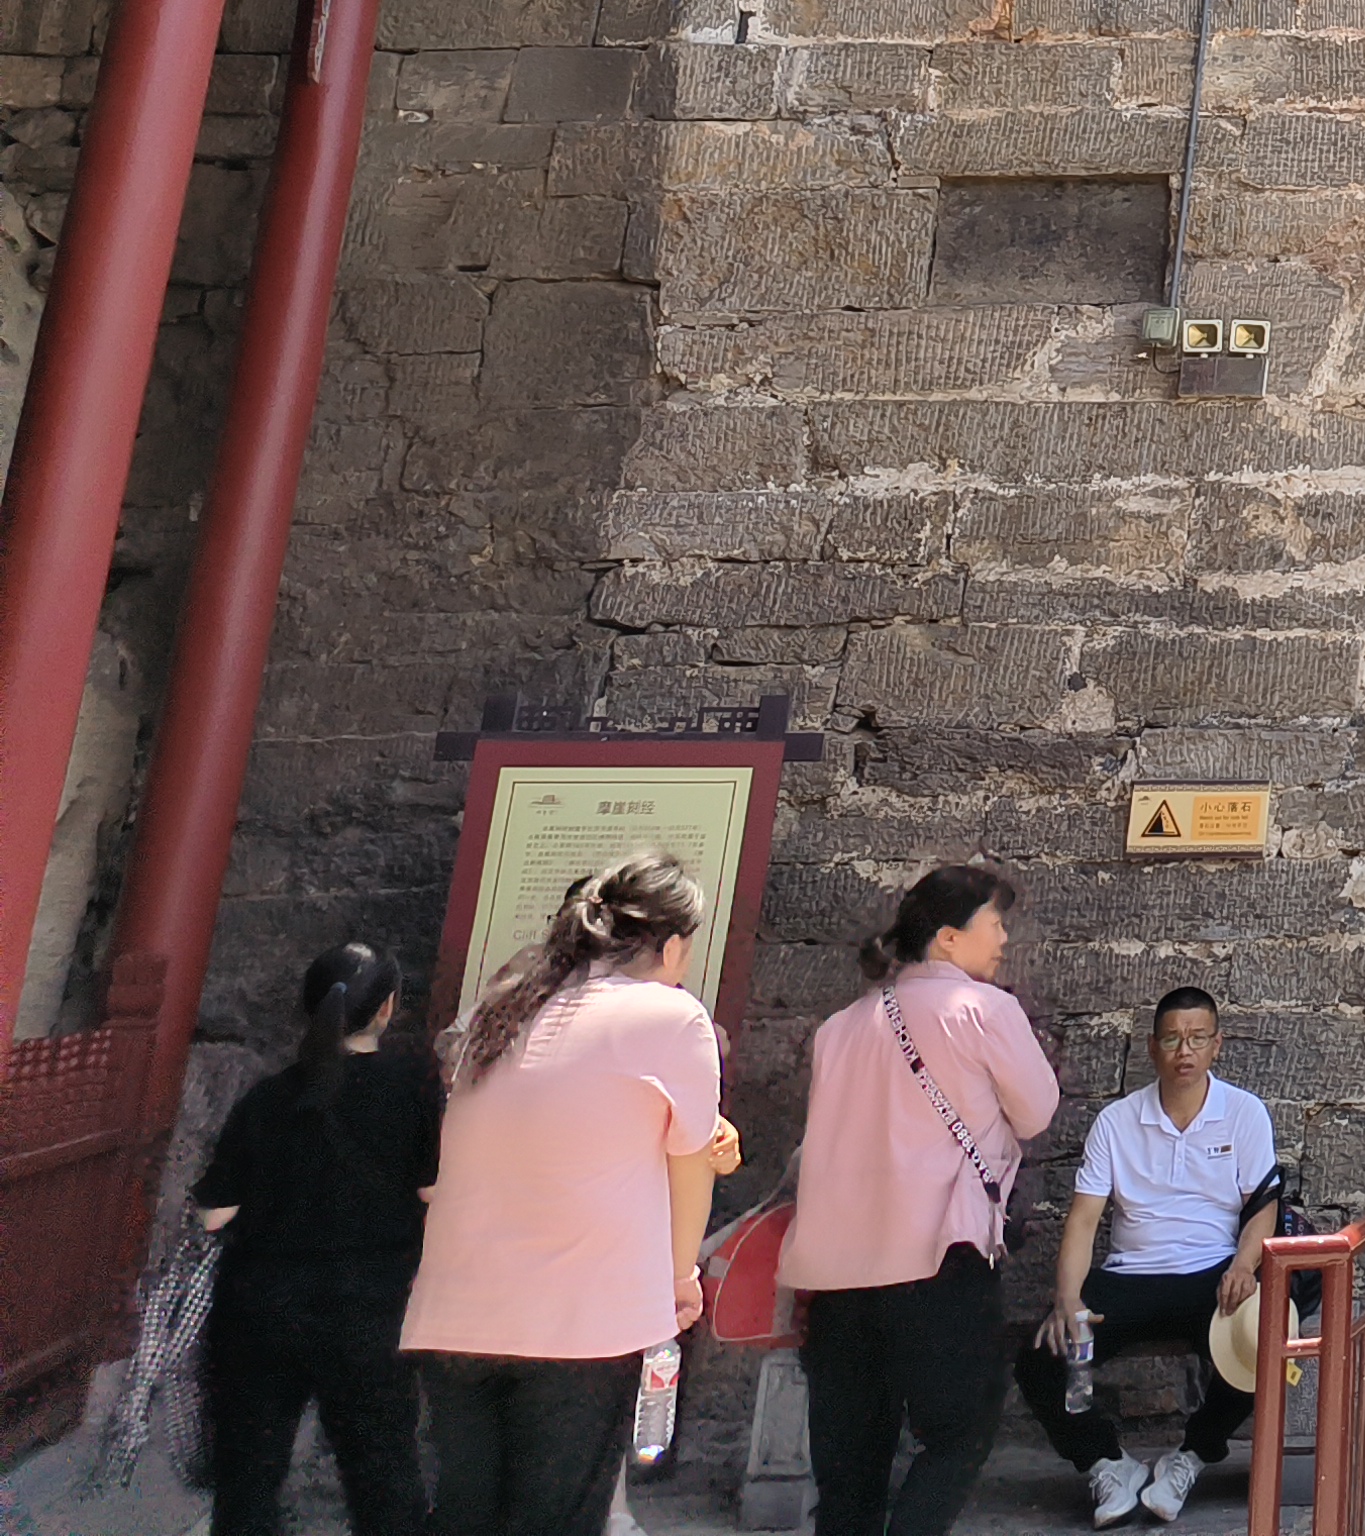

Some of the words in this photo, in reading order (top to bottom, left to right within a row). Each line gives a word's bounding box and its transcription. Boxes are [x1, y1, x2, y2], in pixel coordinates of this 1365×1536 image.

[596, 800, 656, 815] 摩崖刻经
[1200, 801, 1252, 813] 小心落石
